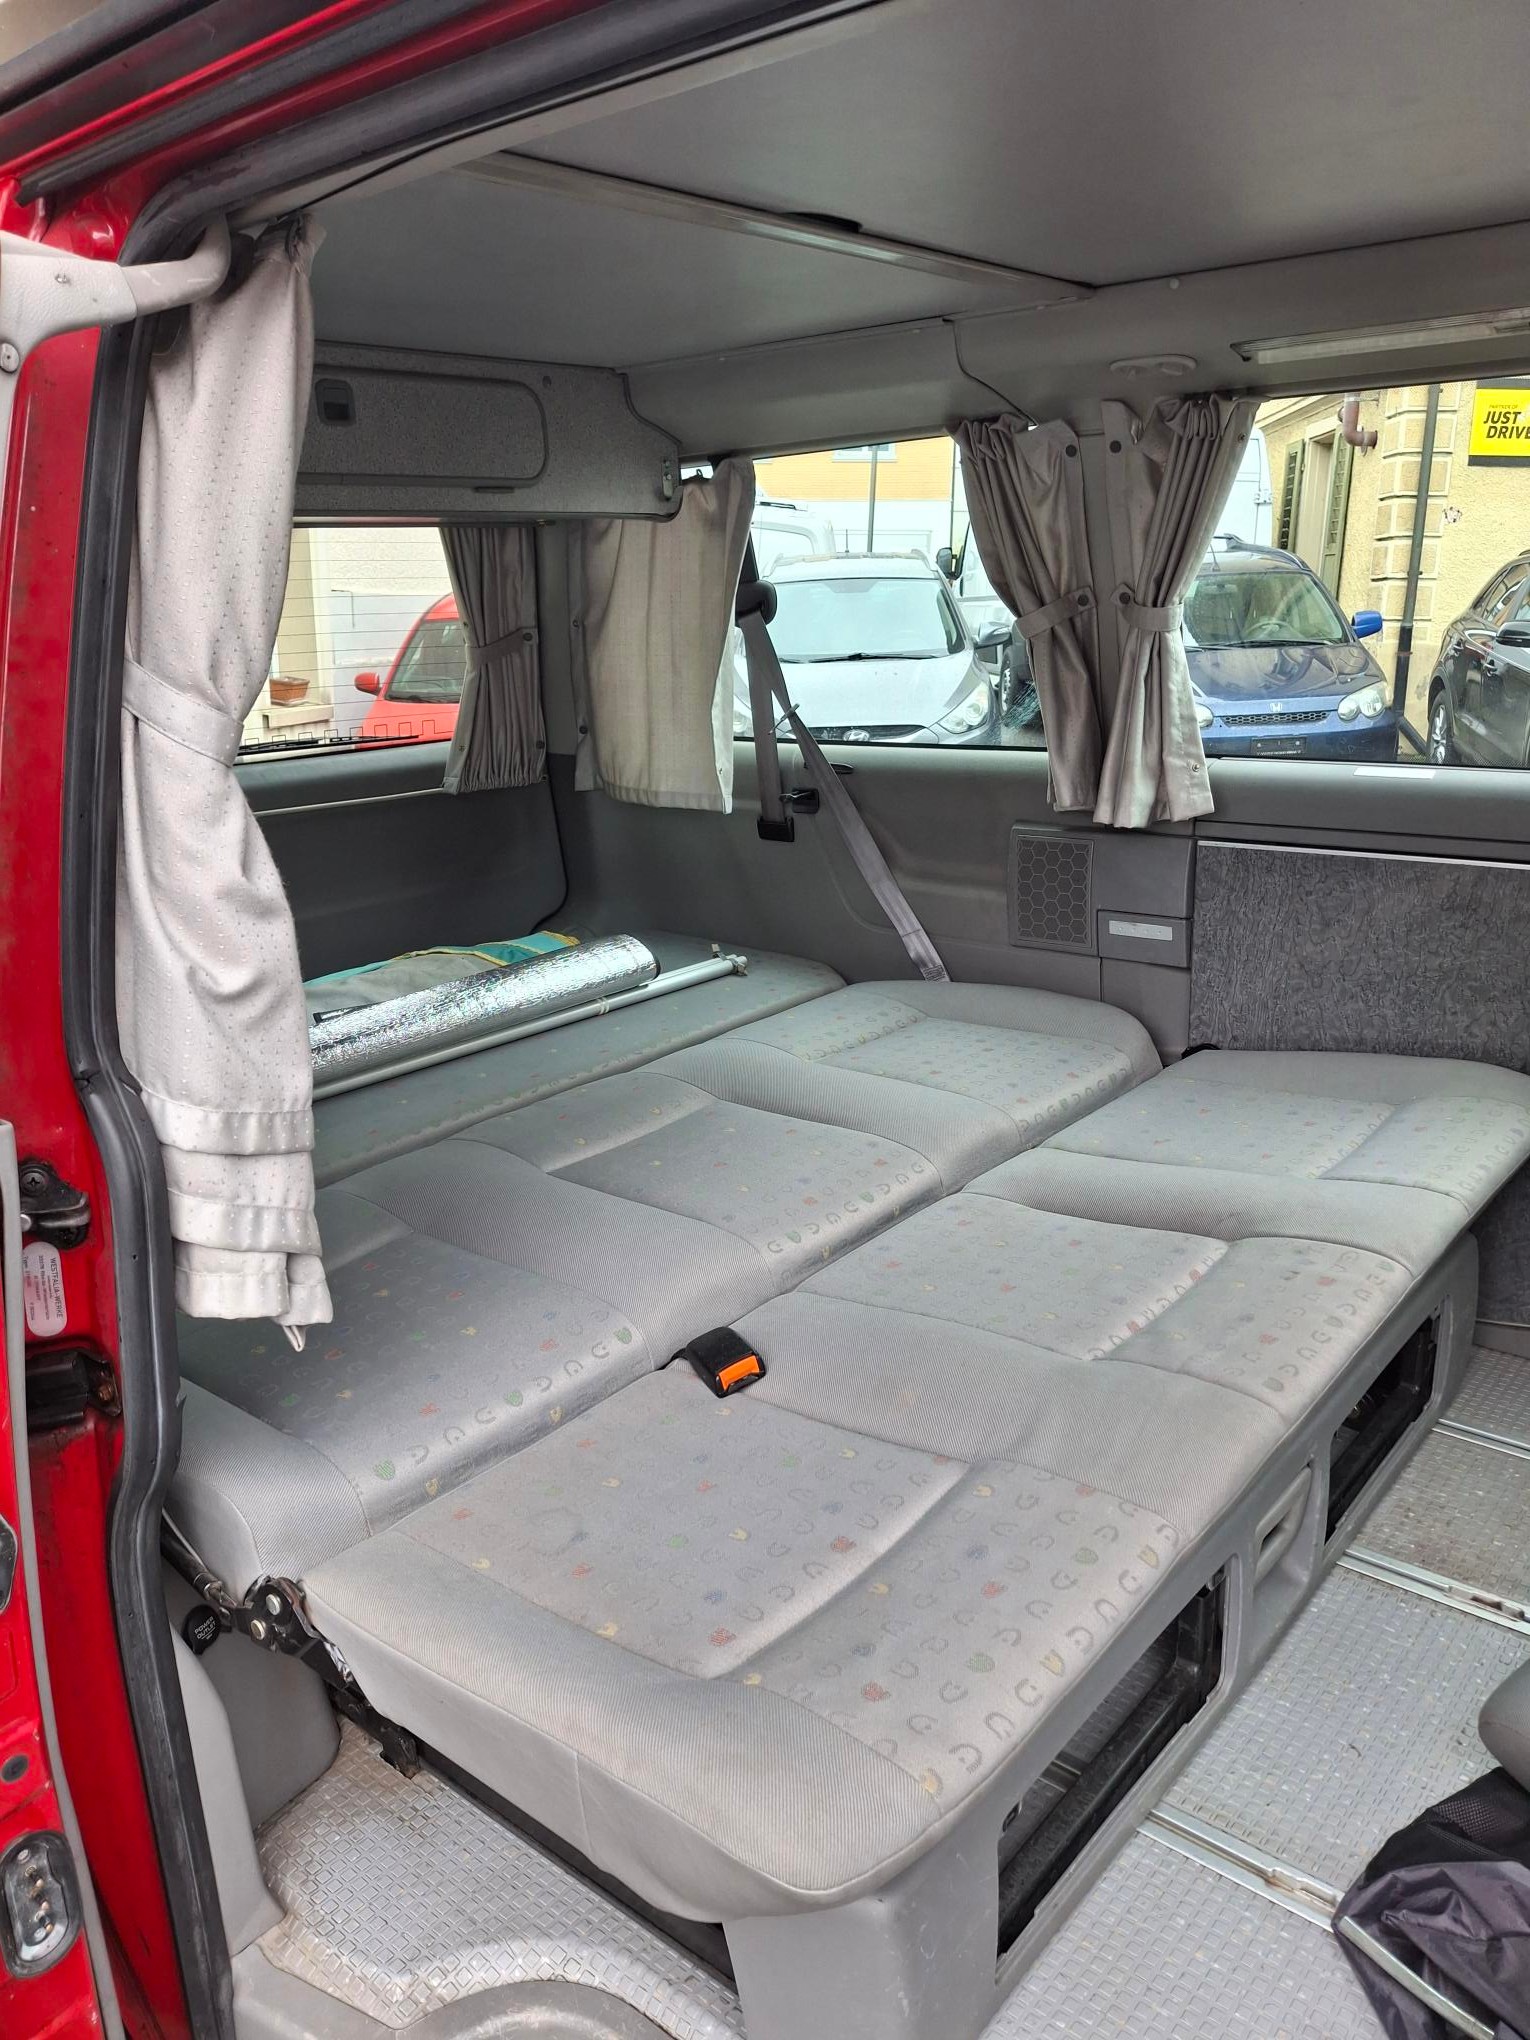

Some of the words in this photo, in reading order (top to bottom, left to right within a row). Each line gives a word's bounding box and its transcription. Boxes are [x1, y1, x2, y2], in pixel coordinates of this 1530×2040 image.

[1483, 411, 1522, 425] JUST
[50, 1257, 64, 1319] WESTFALIA-WERKE
[194, 1615, 214, 1634] POWER
[196, 1620, 216, 1640] OUTLET
